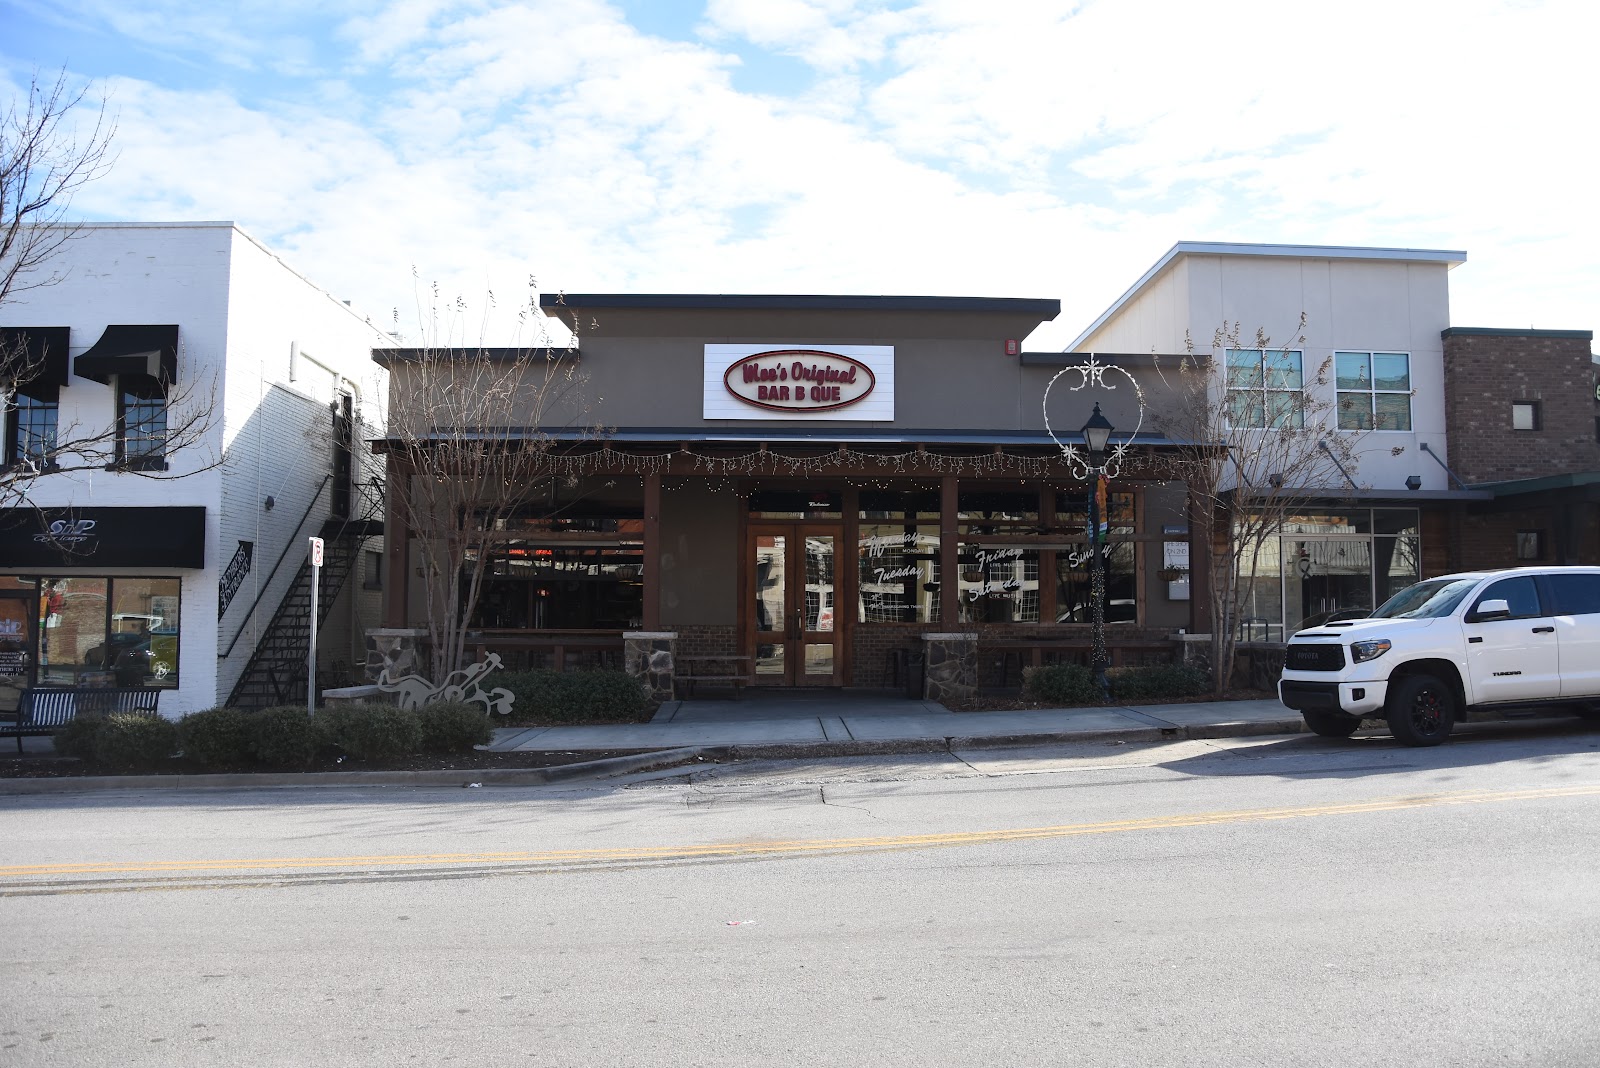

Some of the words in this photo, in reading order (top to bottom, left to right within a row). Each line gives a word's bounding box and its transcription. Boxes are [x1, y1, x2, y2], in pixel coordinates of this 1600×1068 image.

[743, 363, 787, 383] Moe's
[791, 362, 857, 385] Original
[758, 385, 789, 401] BAR
[795, 386, 805, 400] B
[811, 386, 840, 402] QUE
[975, 548, 1024, 573] Friday
[1069, 544, 1112, 568] Sundy
[873, 565, 925, 587] Tuesday
[1297, 652, 1319, 660] TOYOTA
